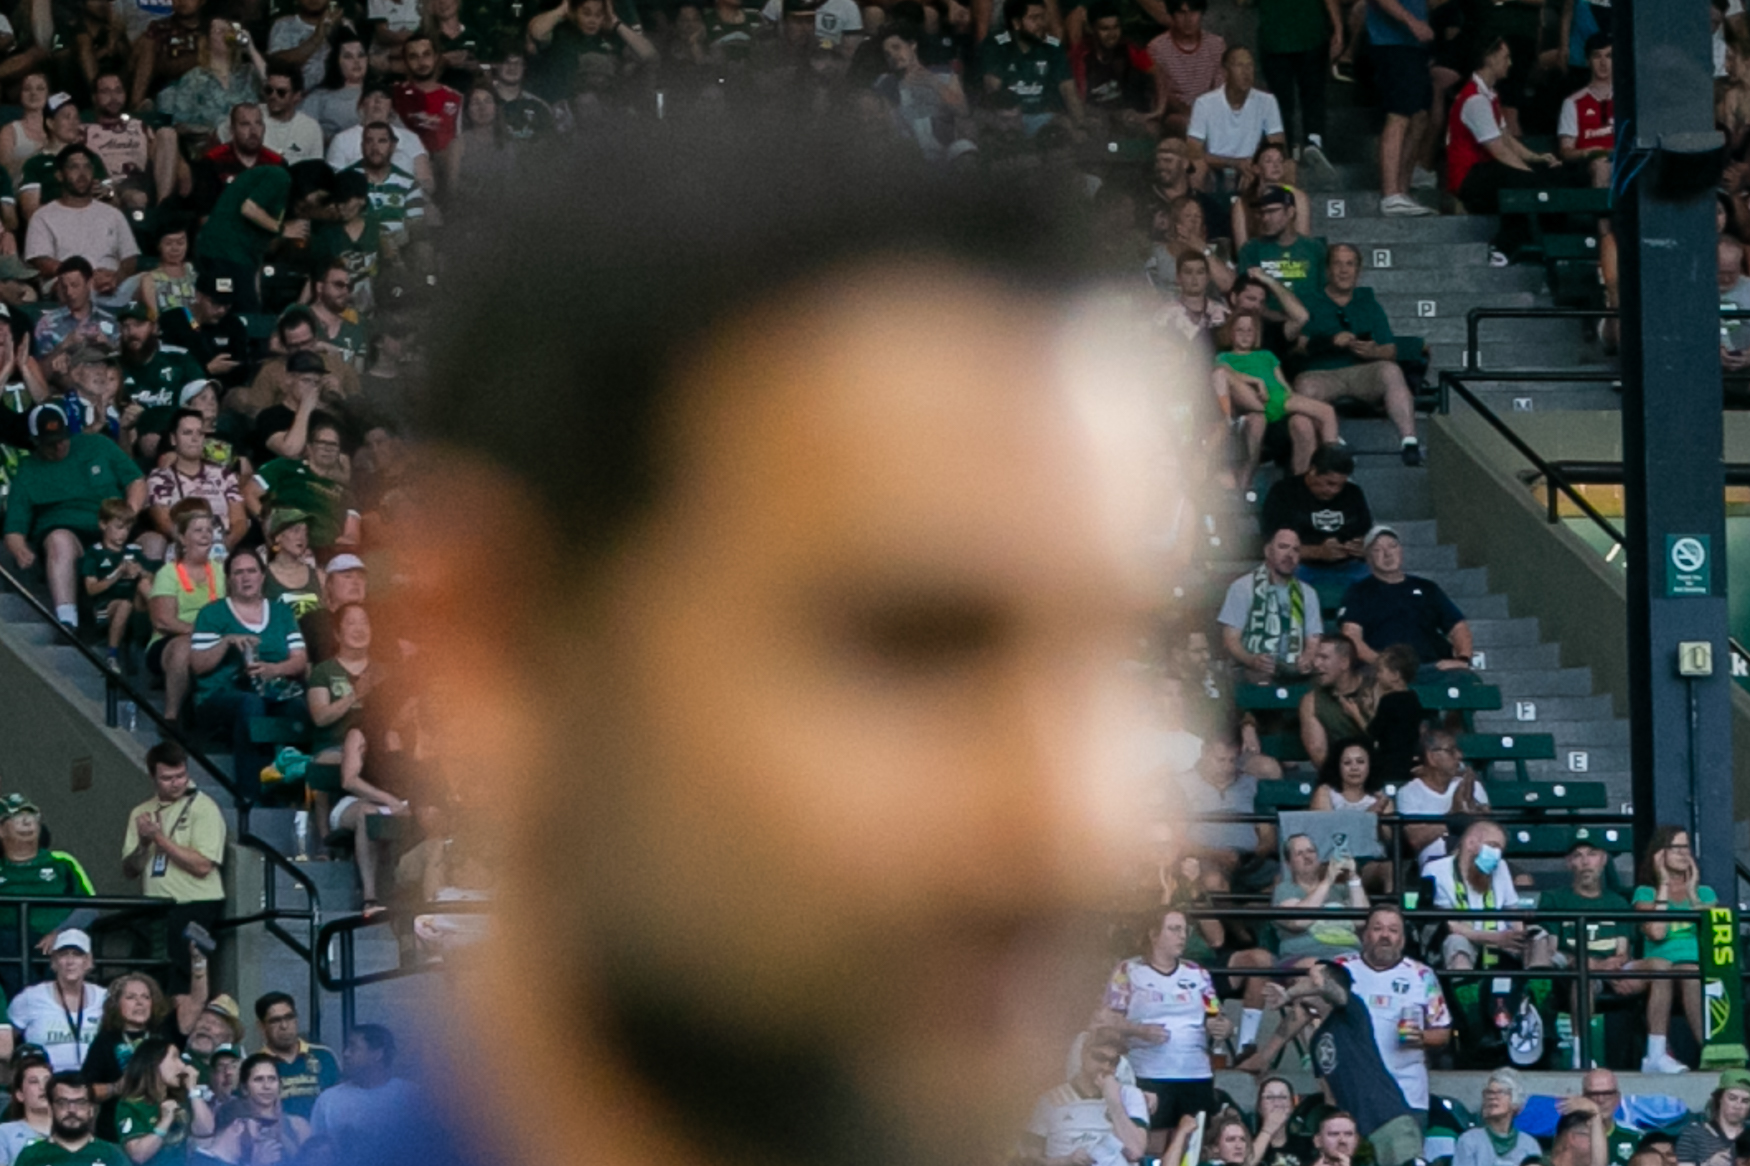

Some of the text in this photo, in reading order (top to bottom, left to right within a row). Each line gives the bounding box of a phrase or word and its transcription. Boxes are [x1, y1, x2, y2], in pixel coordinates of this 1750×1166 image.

[1330, 200, 1343, 216] S
[1376, 250, 1389, 267] R
[1419, 301, 1434, 317] P
